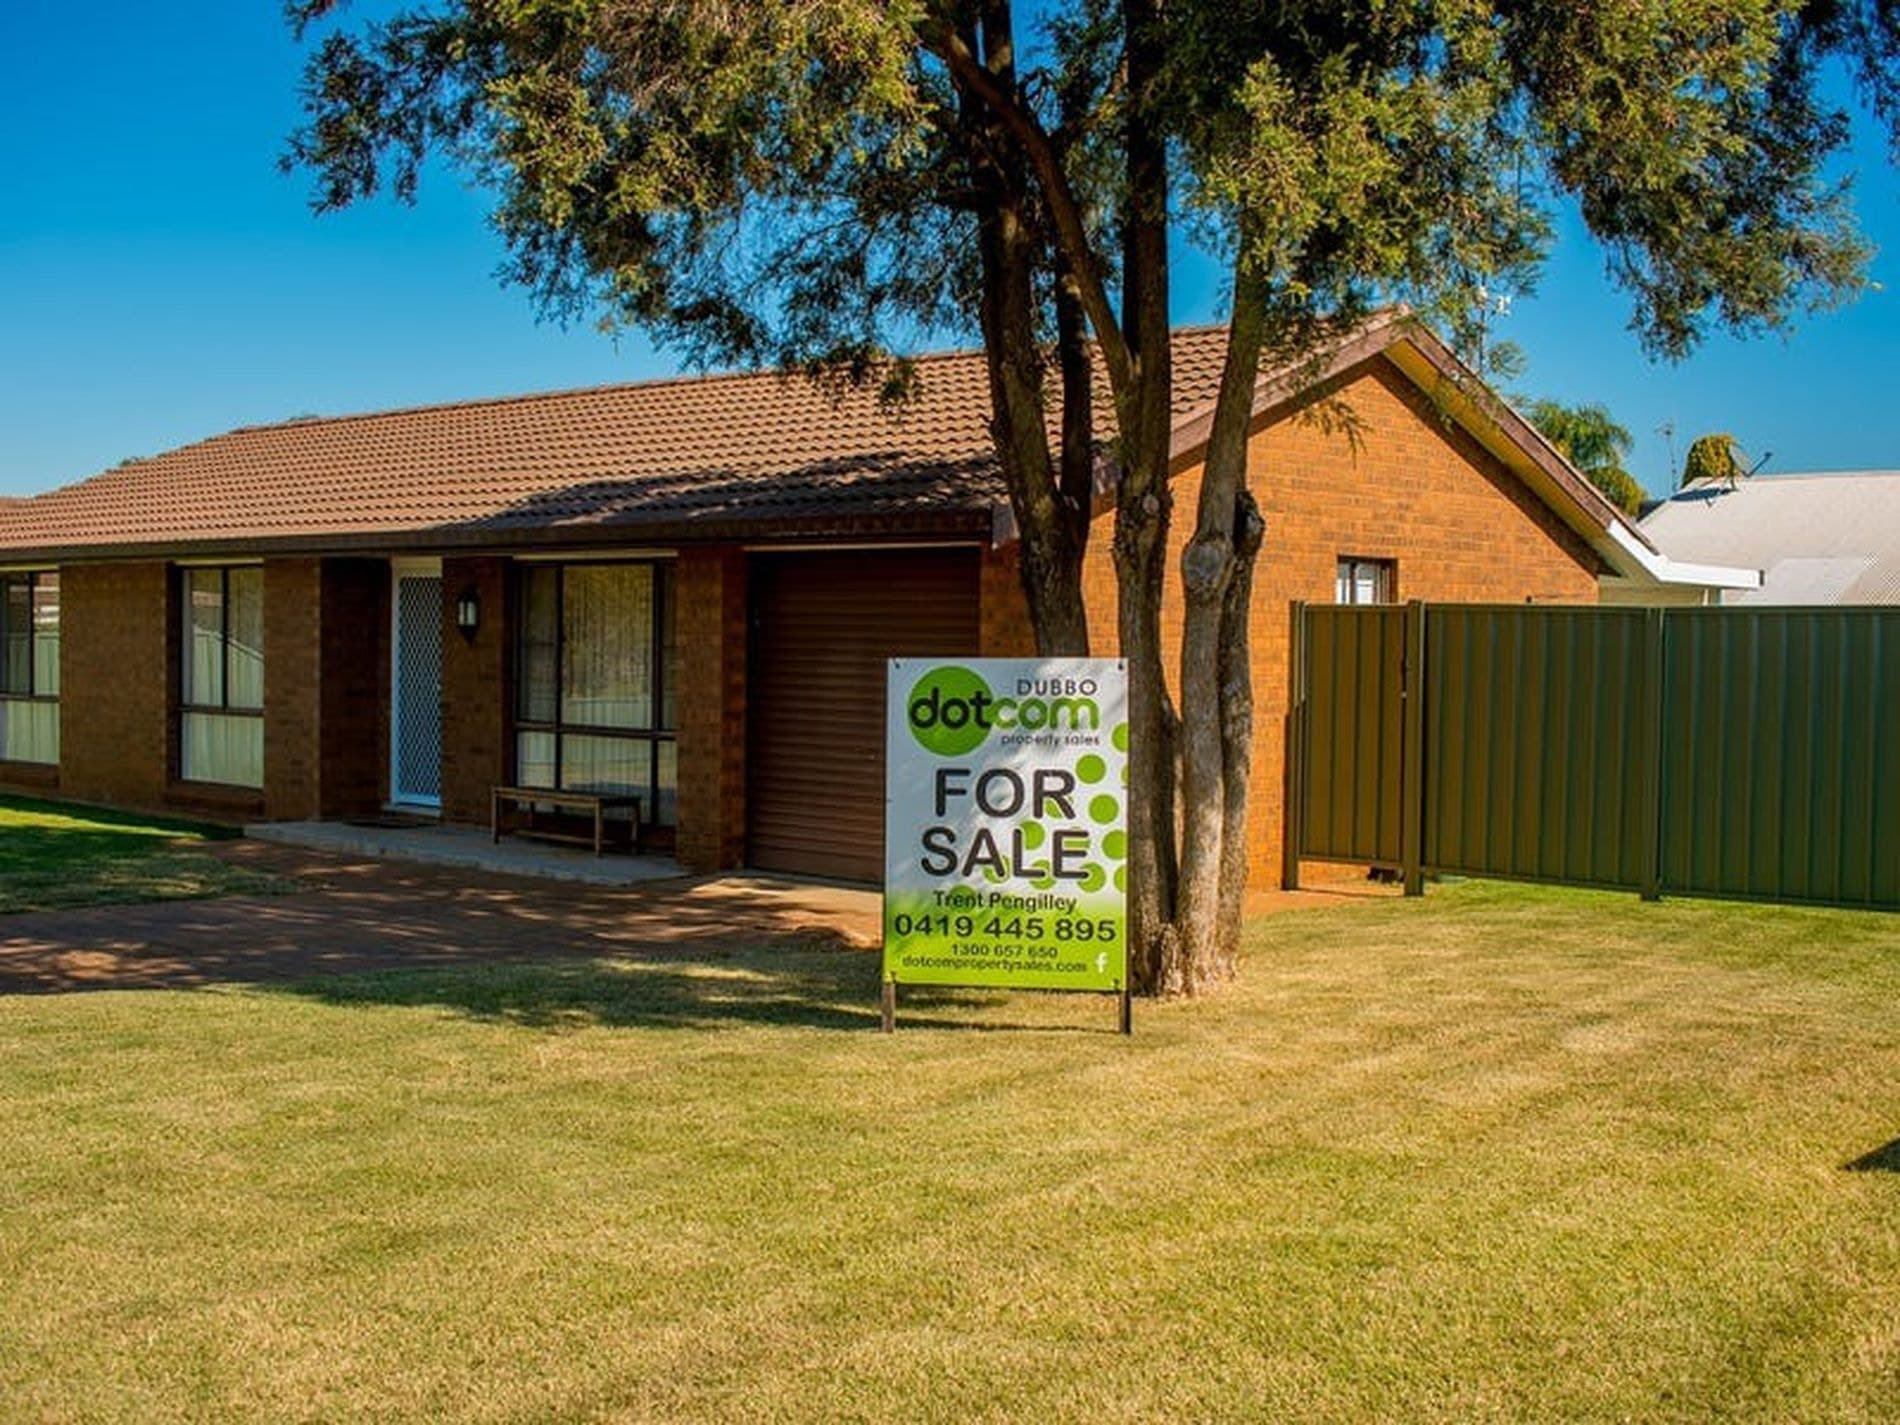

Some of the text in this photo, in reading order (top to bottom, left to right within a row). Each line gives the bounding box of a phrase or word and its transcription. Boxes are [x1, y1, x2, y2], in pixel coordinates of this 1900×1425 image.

[1017, 679, 1098, 696] DUBBO
[911, 687, 1100, 730] dotcom
[1001, 734, 1100, 747] property sales
[935, 768, 1076, 819] FOR
[920, 827, 1089, 879] SALE
[933, 891, 1077, 914] Trent Pengilley
[894, 914, 1116, 942] 0419 445 895
[951, 943, 1058, 958] 1300 657 650
[902, 956, 1087, 973] dotcompropertysales.com
